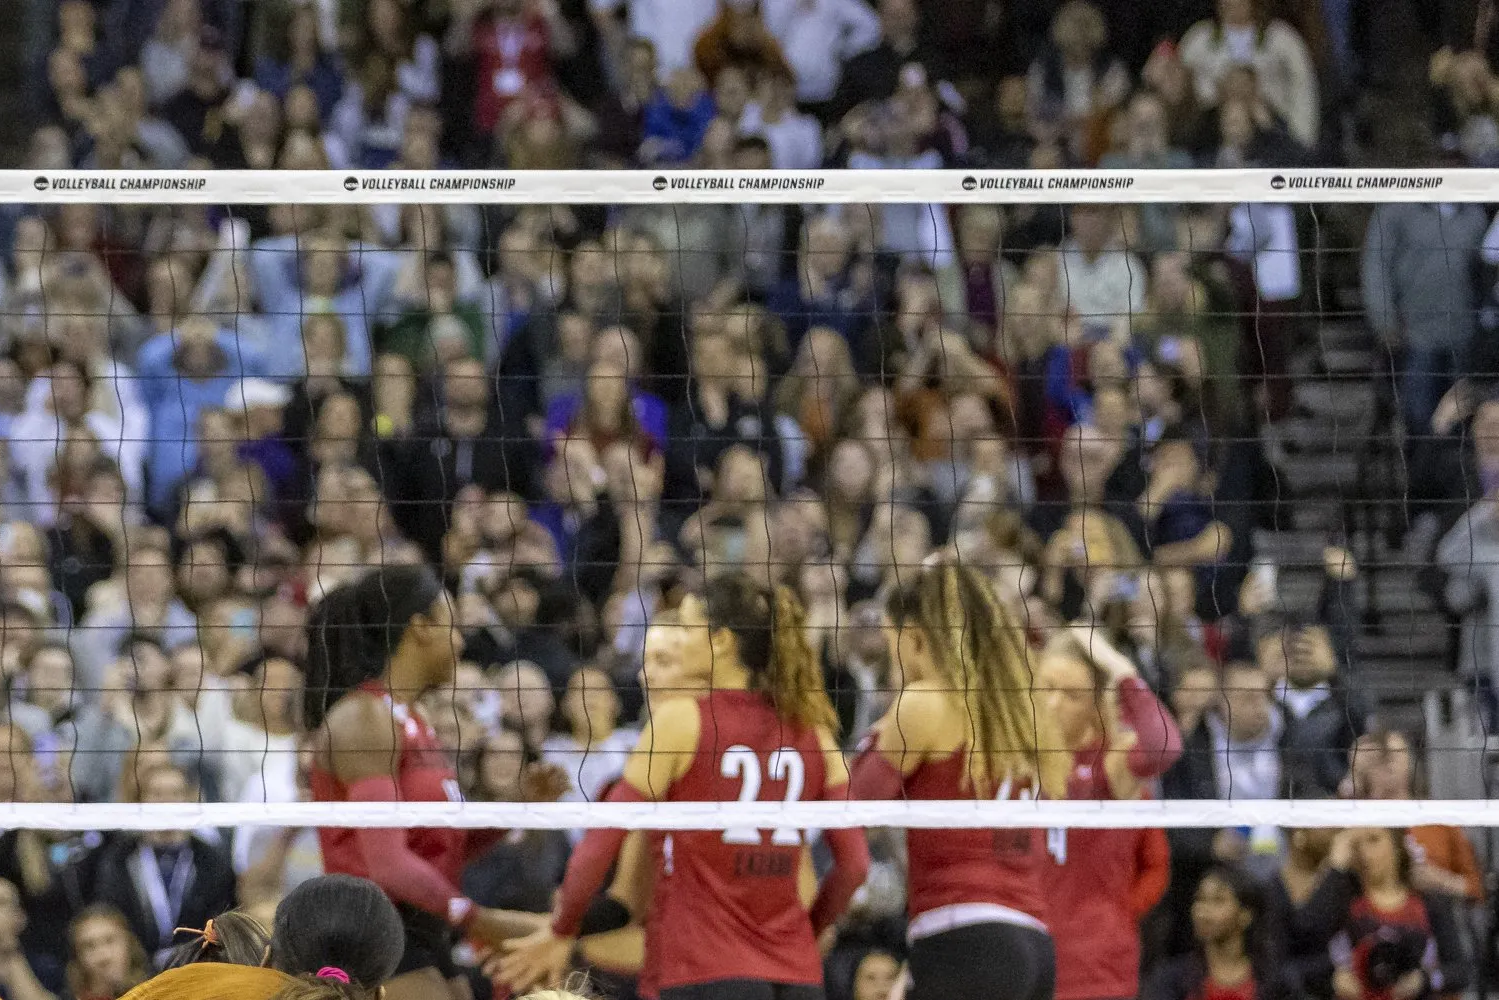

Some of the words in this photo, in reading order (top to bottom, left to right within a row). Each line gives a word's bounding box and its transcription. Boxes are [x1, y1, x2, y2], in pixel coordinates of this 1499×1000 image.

[52, 177, 116, 189] VOLLEYBALL
[119, 177, 206, 189] CHAMPIONSHIP
[362, 177, 426, 189] VOLLEYBALL
[429, 177, 516, 189] CHAMPIONSHIP
[671, 177, 734, 189] VOLLEYBALL
[738, 177, 825, 189] CHAMPIONSHIP
[980, 177, 1044, 189] VOLLEYBALL
[1047, 177, 1134, 189] CHAMPIONSHIP
[1289, 176, 1353, 188] VOLLEYBALL
[1356, 176, 1443, 188] CHAMPIONSHIP
[720, 744, 805, 847] 22
